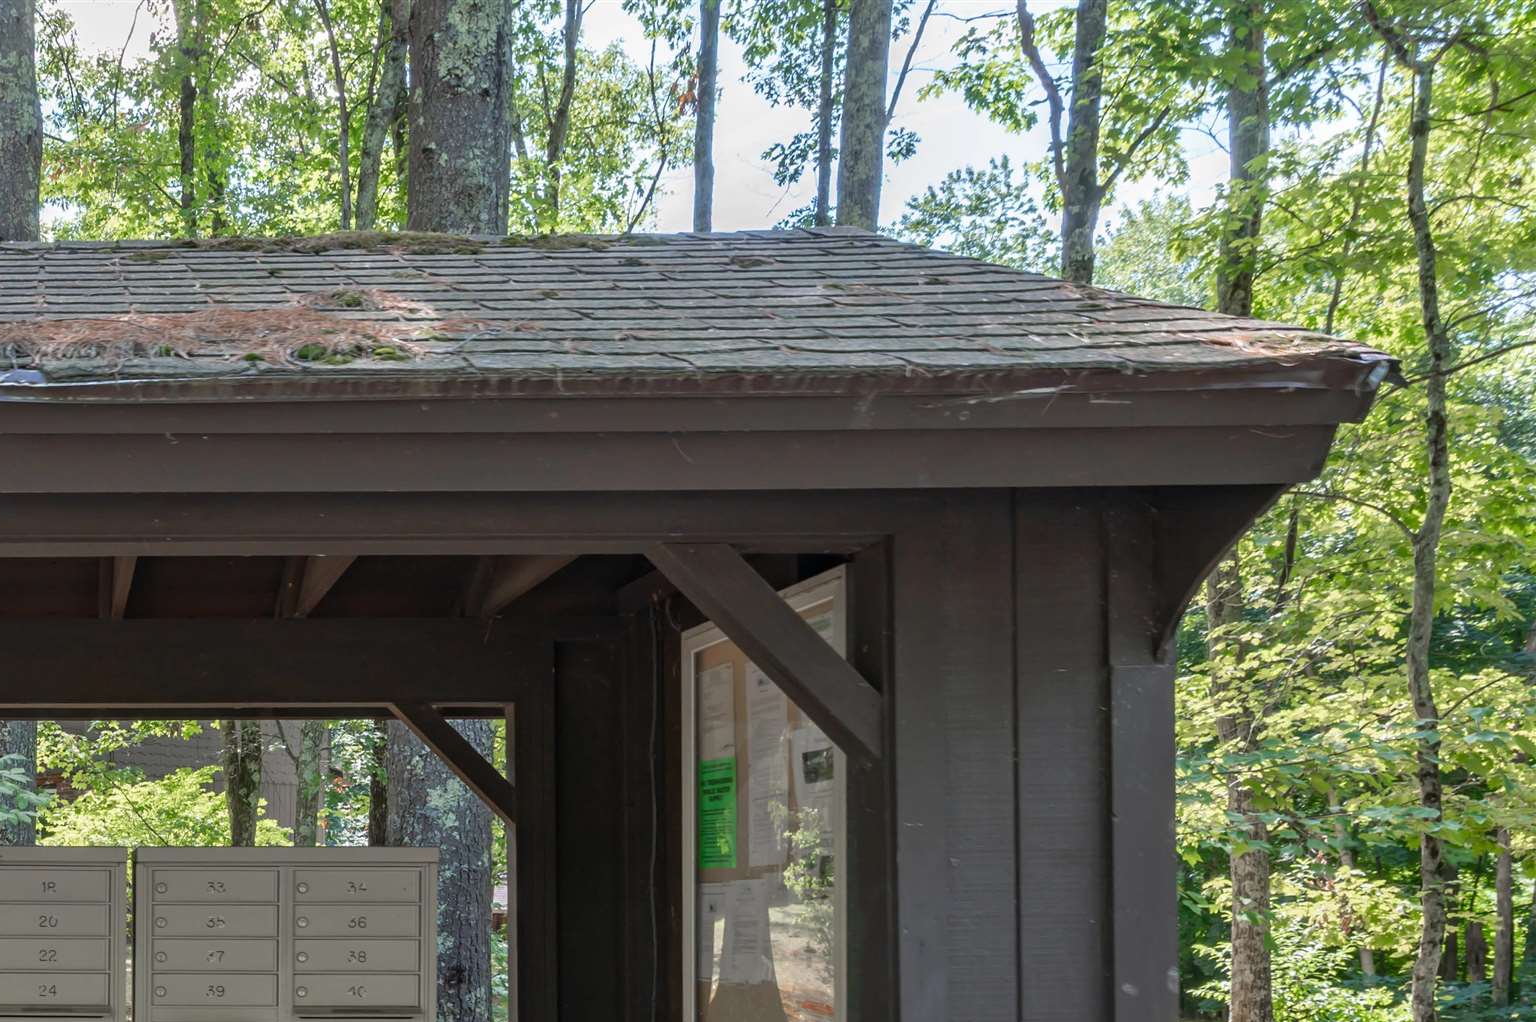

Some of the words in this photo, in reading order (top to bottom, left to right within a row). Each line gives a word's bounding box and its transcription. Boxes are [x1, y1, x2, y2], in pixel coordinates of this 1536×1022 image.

[207, 881, 226, 894] 33
[347, 881, 367, 894] 34
[39, 915, 58, 928] 20
[348, 916, 367, 929] 36
[39, 949, 57, 962] 22
[348, 951, 366, 963] 38
[39, 985, 57, 997] 24
[206, 985, 225, 997] 39
